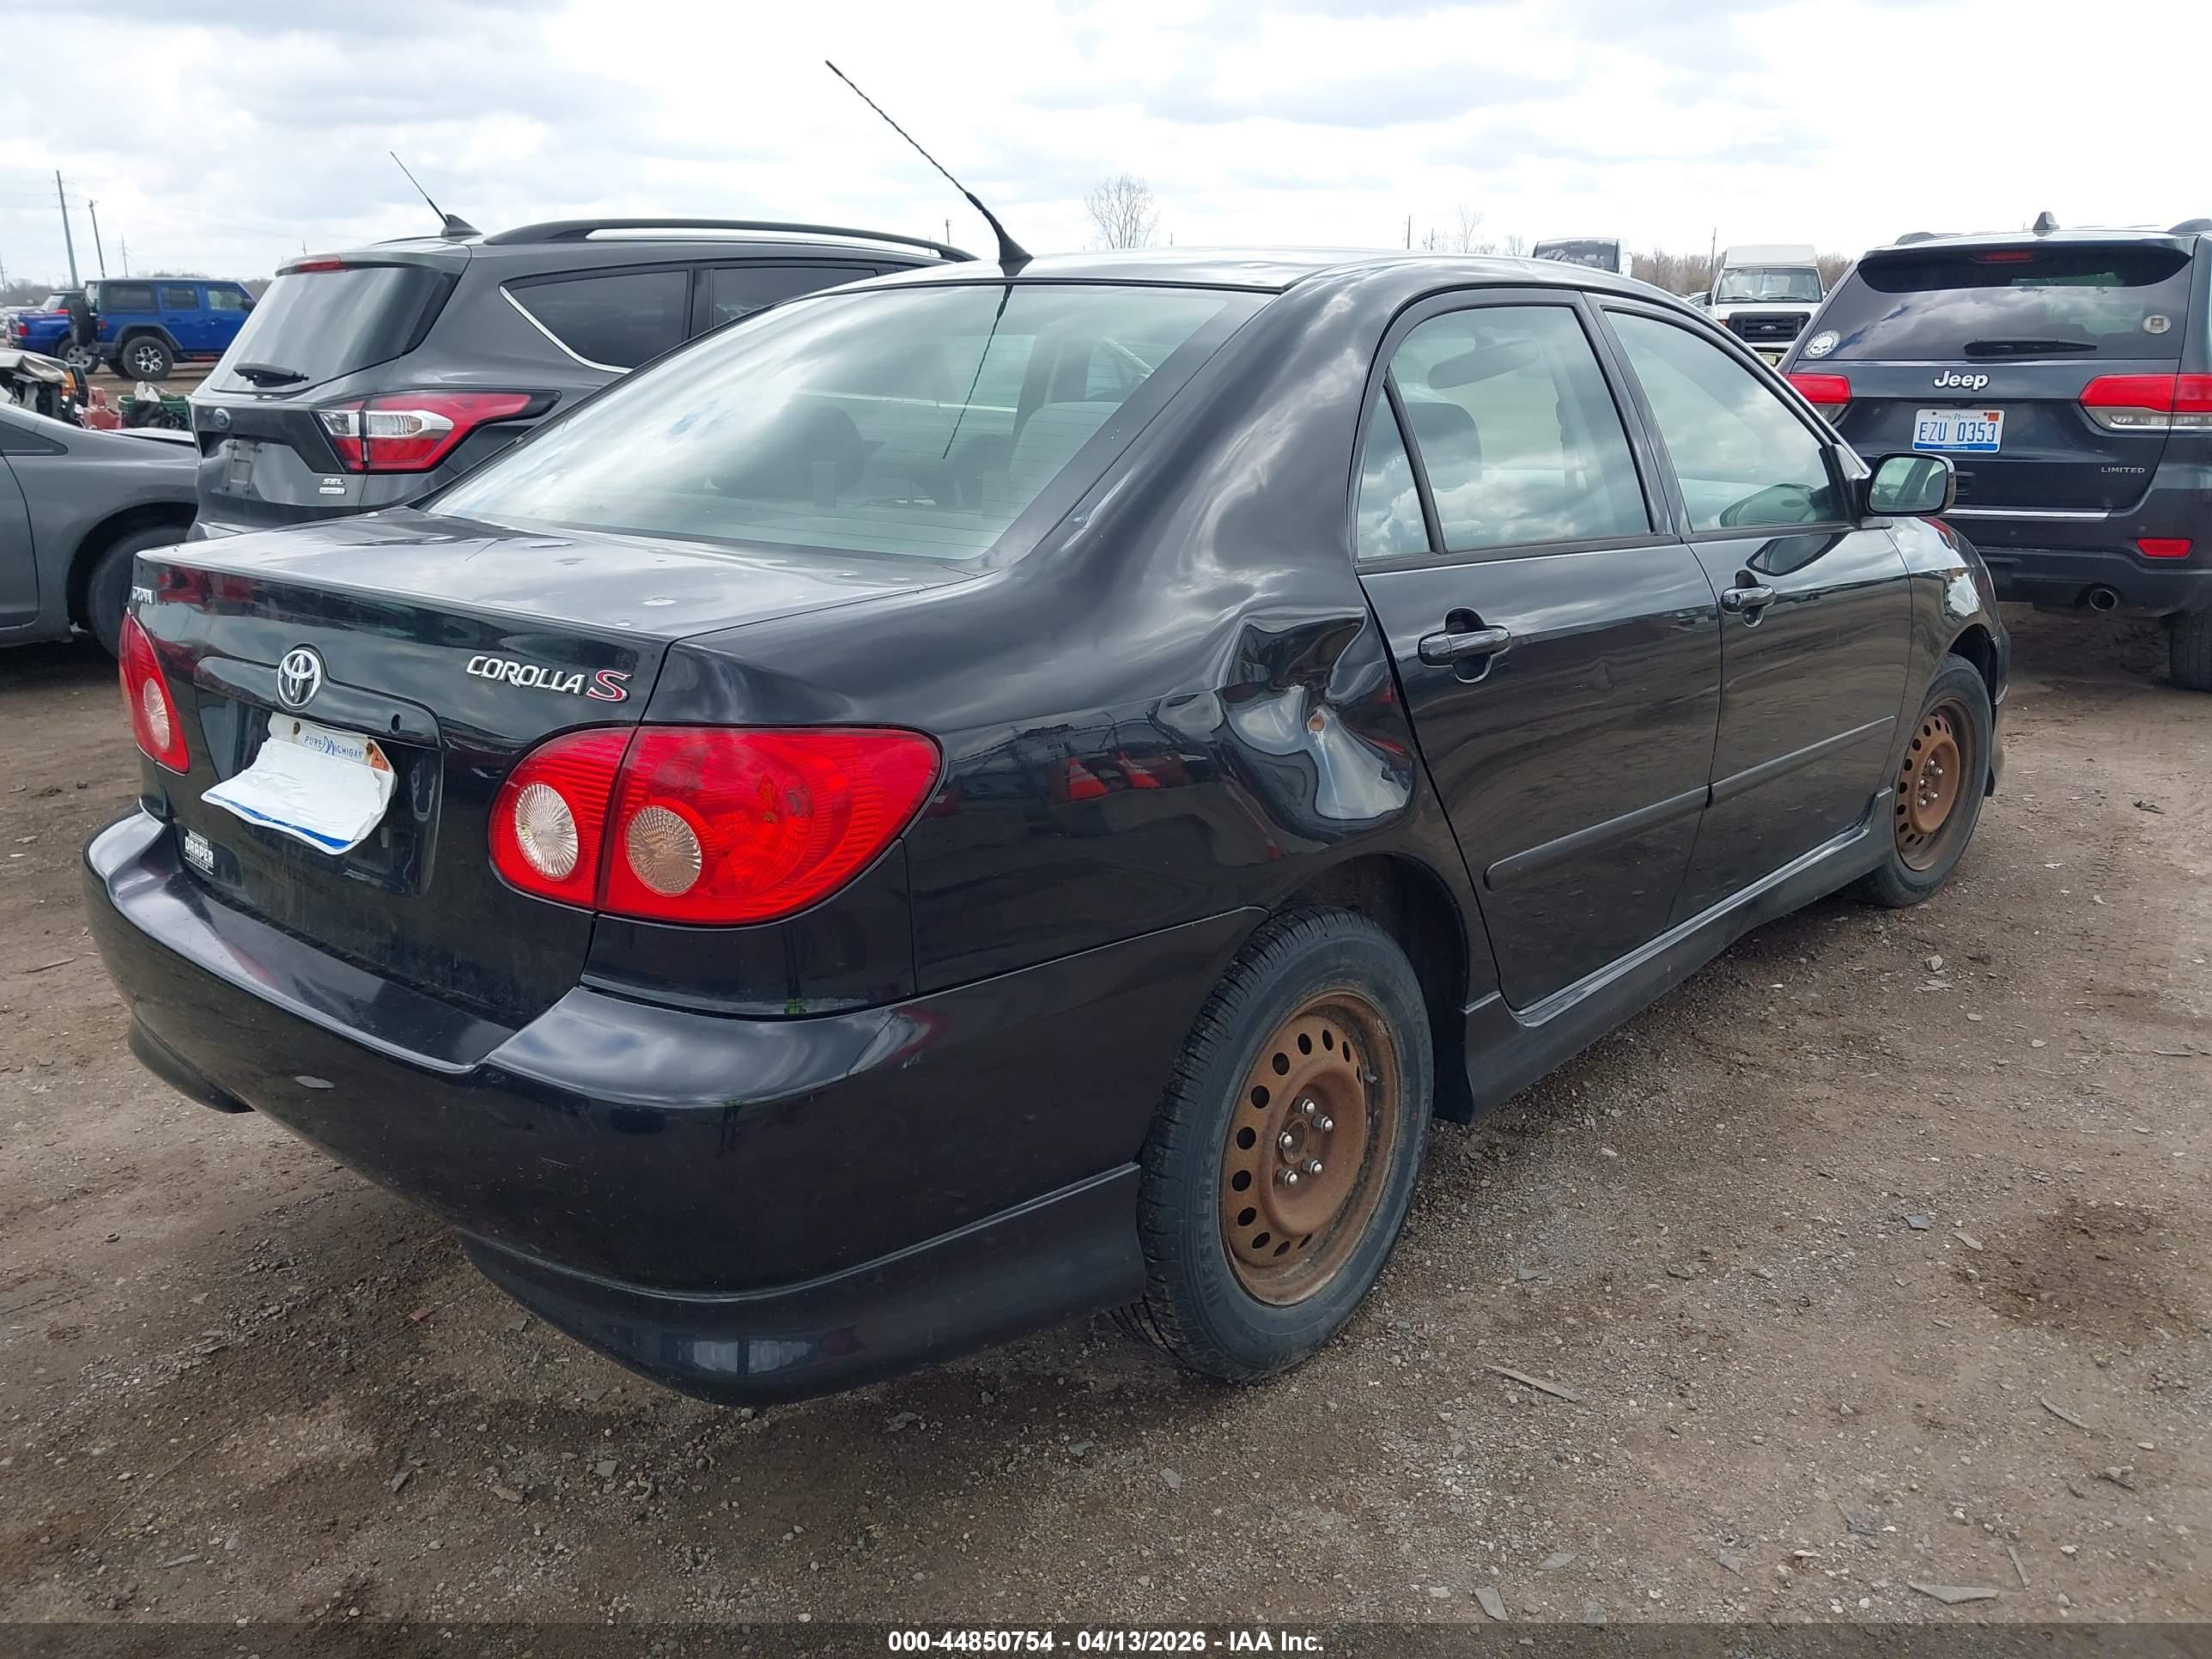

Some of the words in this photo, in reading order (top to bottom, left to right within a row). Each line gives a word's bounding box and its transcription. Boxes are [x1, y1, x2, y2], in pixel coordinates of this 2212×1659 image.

[1933, 370, 1989, 391] Jeep
[1918, 422, 1948, 441] EZU
[1957, 422, 1996, 442] 0353
[466, 655, 586, 695] COROLLA
[586, 669, 632, 702] S
[304, 735, 322, 749] PURE
[319, 735, 364, 759] MICHIGAN
[184, 835, 214, 866] DRAPER
